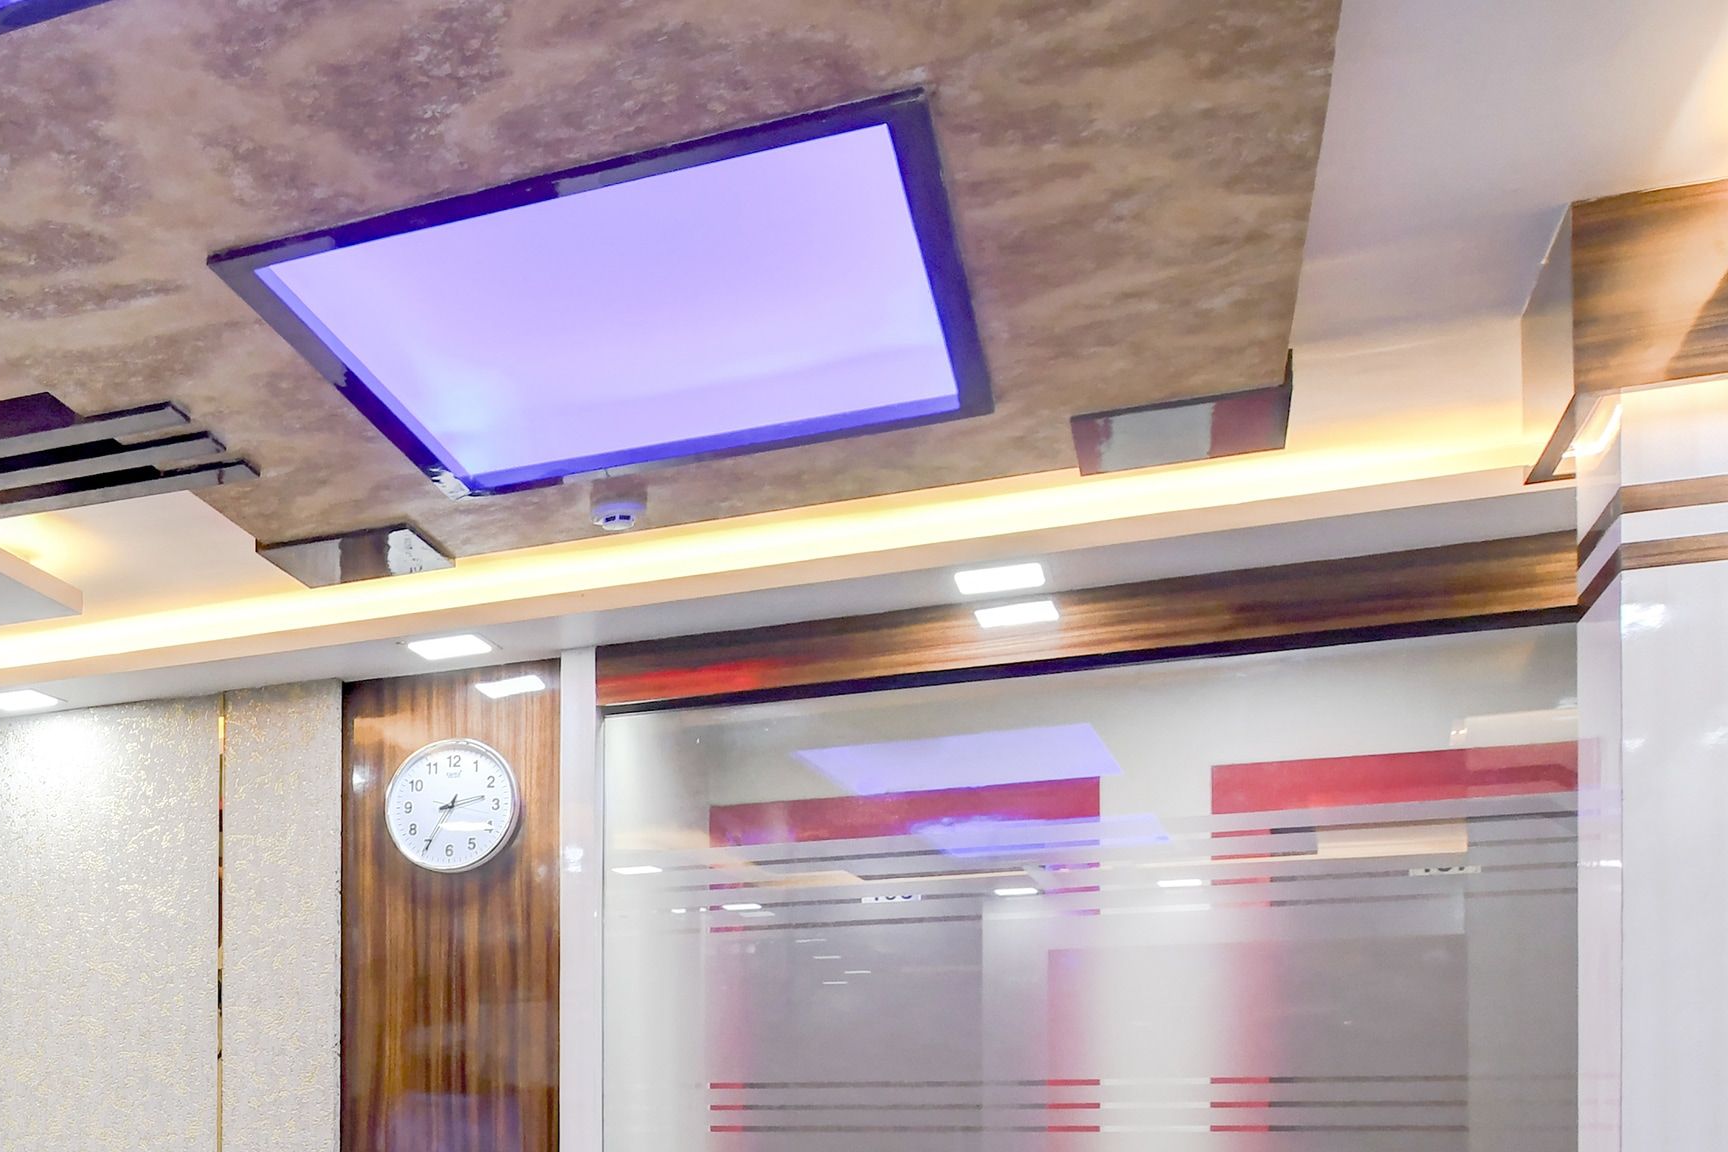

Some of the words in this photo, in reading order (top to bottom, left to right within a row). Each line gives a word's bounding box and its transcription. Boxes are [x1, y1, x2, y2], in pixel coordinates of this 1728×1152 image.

[447, 755, 461, 768] 12
[473, 760, 479, 772] 1
[426, 762, 438, 775] 11
[409, 779, 423, 792] 10
[487, 776, 495, 788] 2
[404, 801, 413, 814] 9
[491, 798, 500, 811] 3
[408, 823, 417, 836] 8
[424, 839, 432, 851] 7
[445, 844, 454, 857] 6
[467, 838, 476, 850] 5
